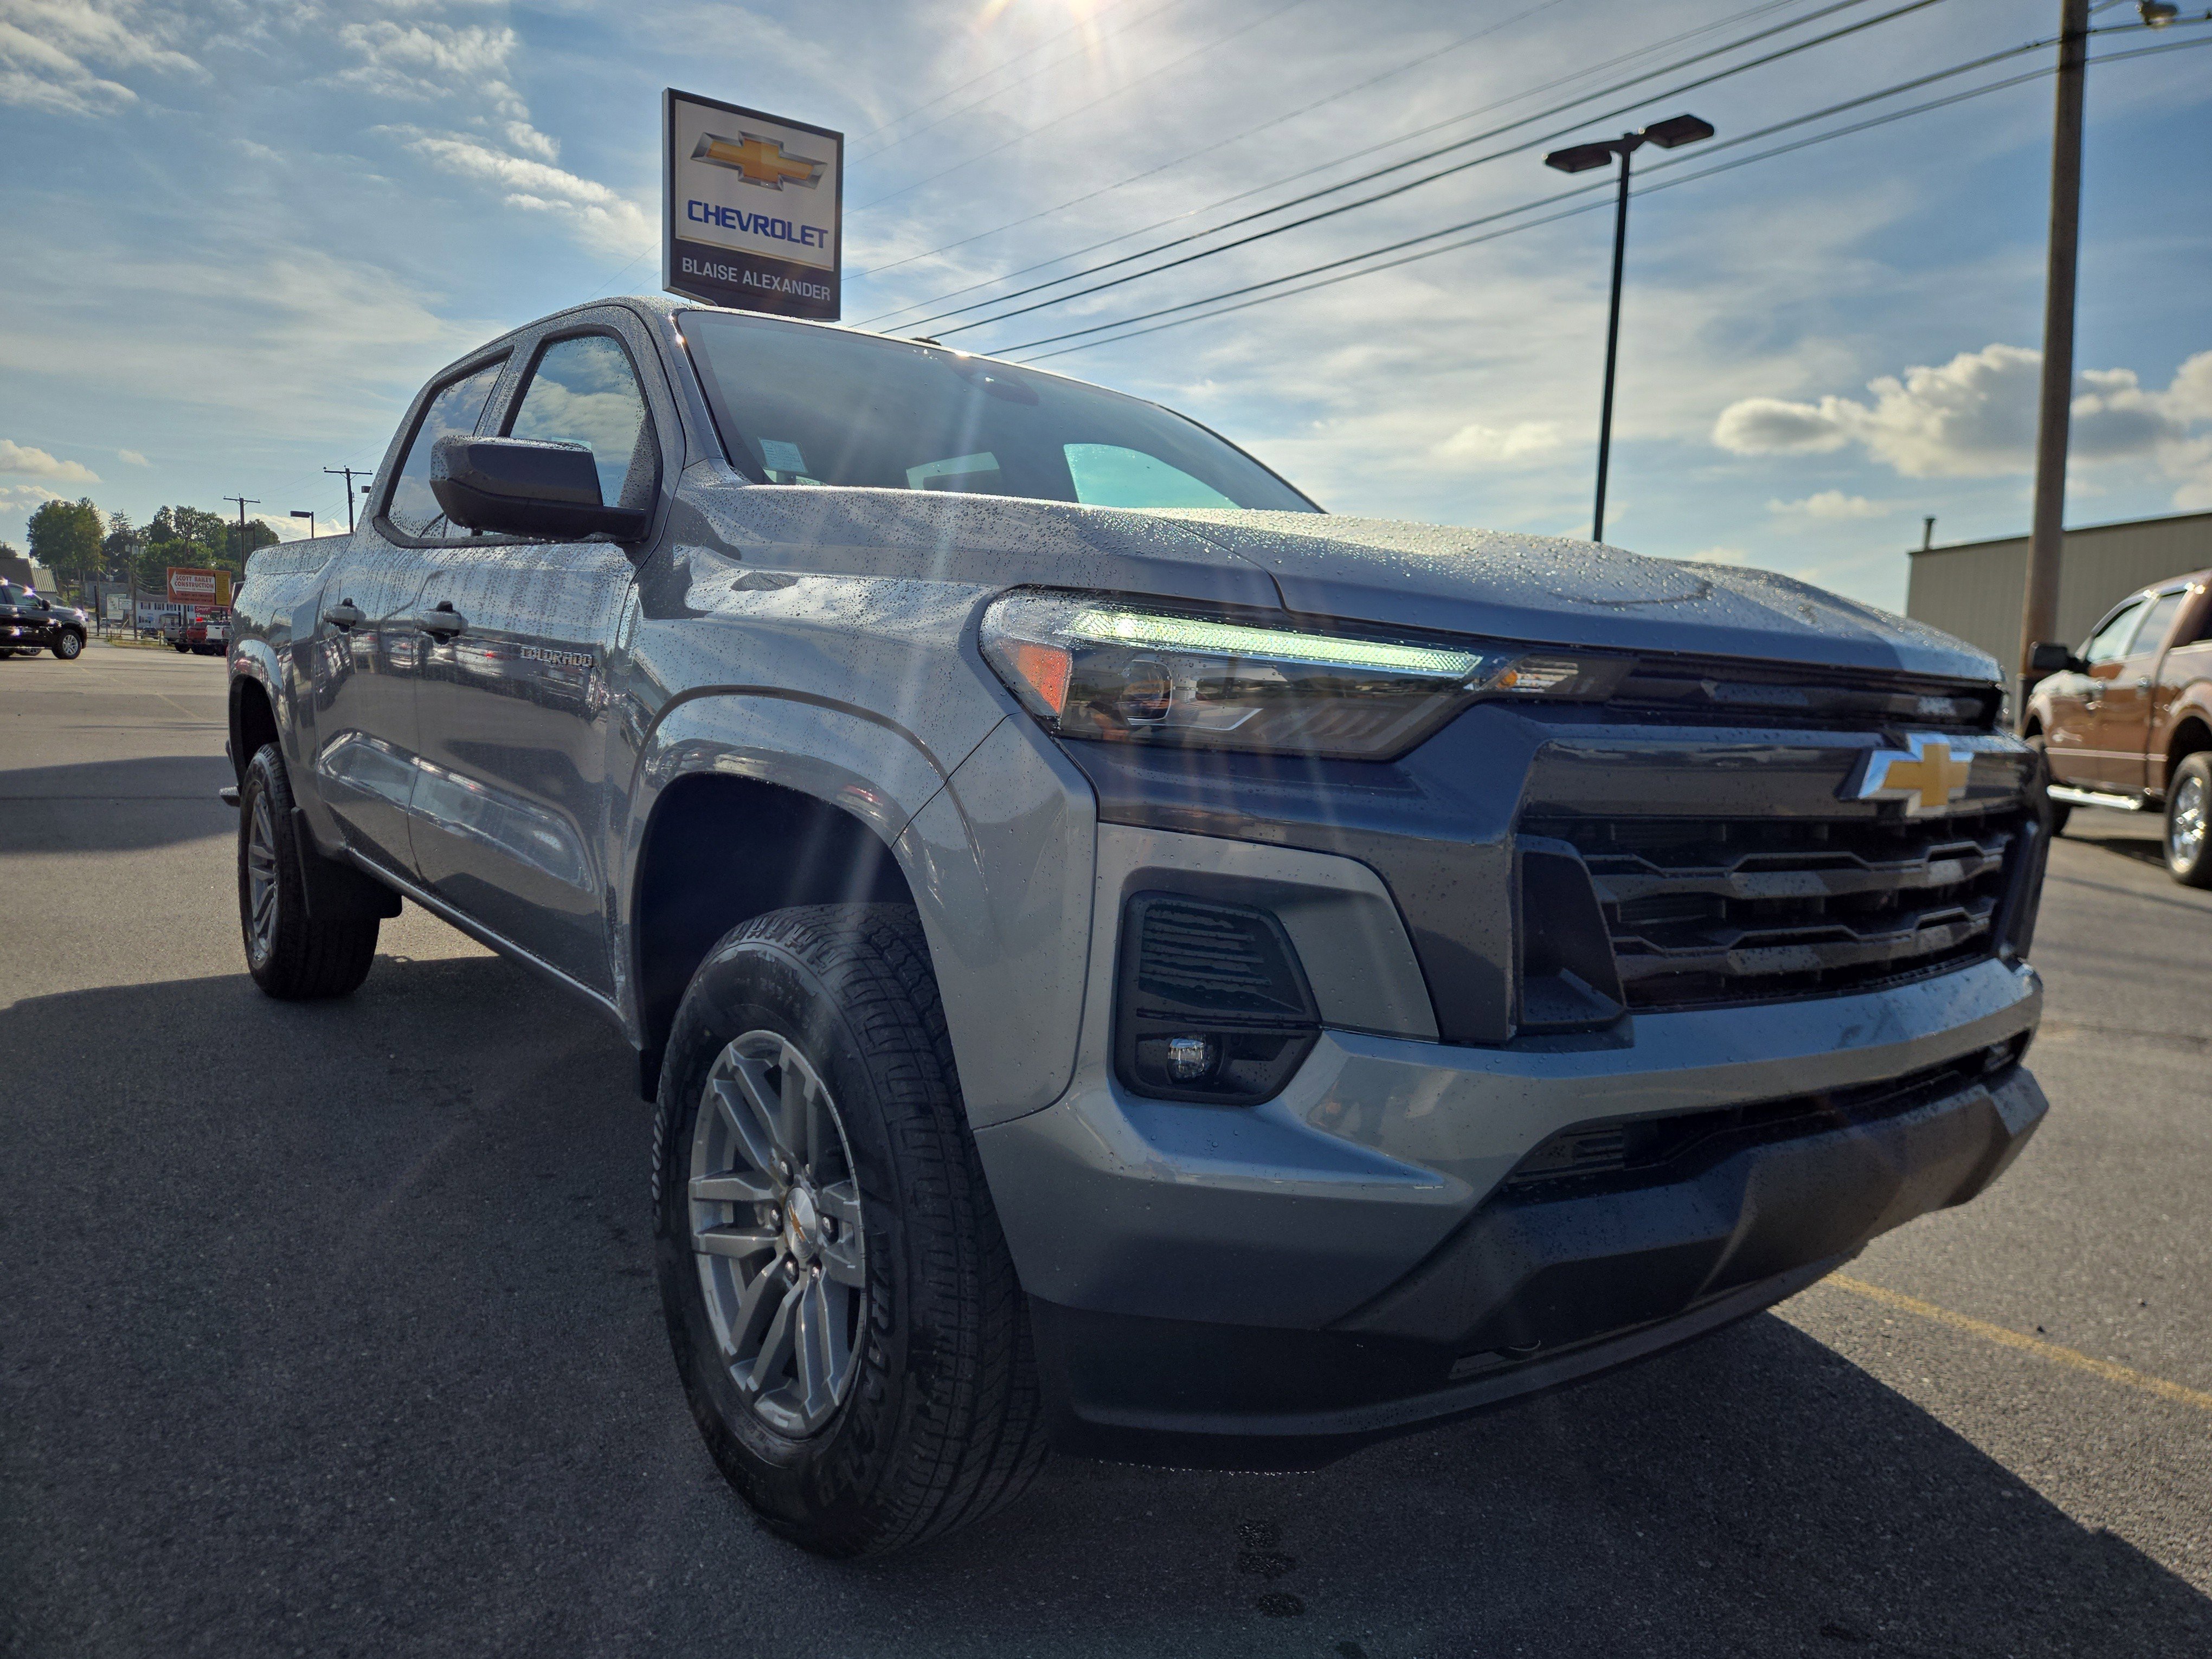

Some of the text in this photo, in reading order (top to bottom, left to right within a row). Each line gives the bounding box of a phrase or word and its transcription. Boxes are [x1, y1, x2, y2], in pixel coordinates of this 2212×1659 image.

[687, 200, 828, 249] CHEVROLET
[682, 257, 831, 301] BLAISE ALEXANDER
[520, 646, 595, 668] COLORADO
